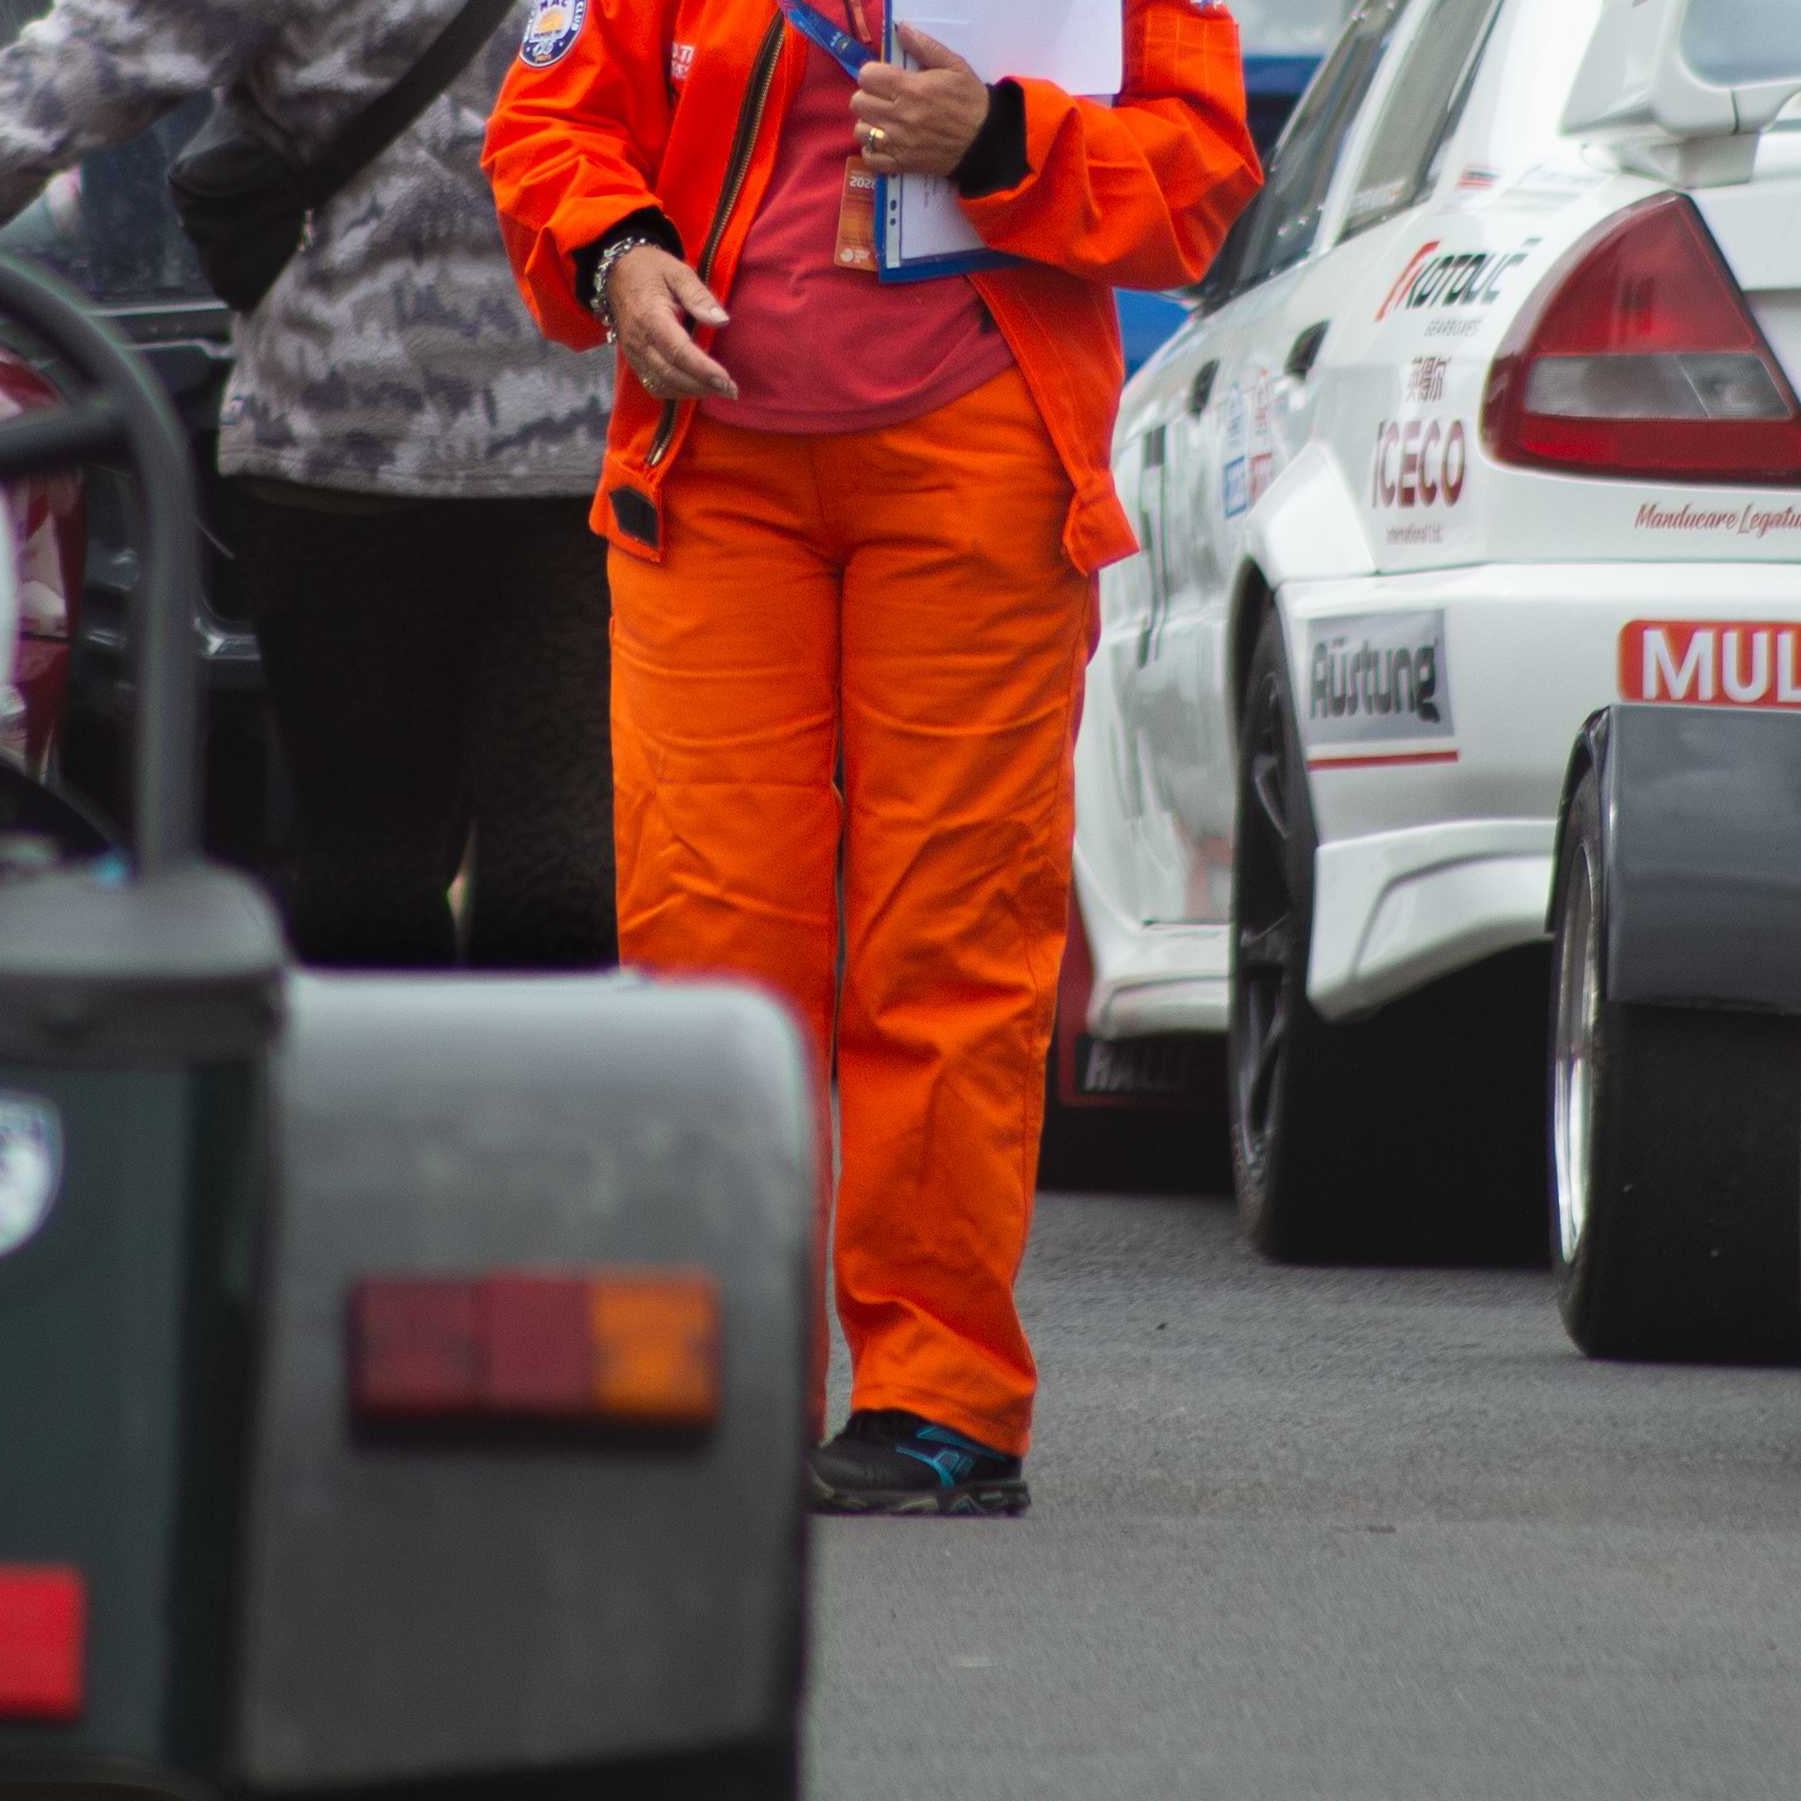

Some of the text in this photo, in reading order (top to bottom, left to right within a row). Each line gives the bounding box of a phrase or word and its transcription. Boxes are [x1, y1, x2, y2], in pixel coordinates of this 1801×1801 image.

[570, 0, 584, 32] CLUB
[1424, 318, 1482, 338] GEARBOXES
[1372, 419, 1465, 508] ICECO
[1634, 501, 1740, 530] Manducare
[1310, 636, 1440, 724] Rüstung
